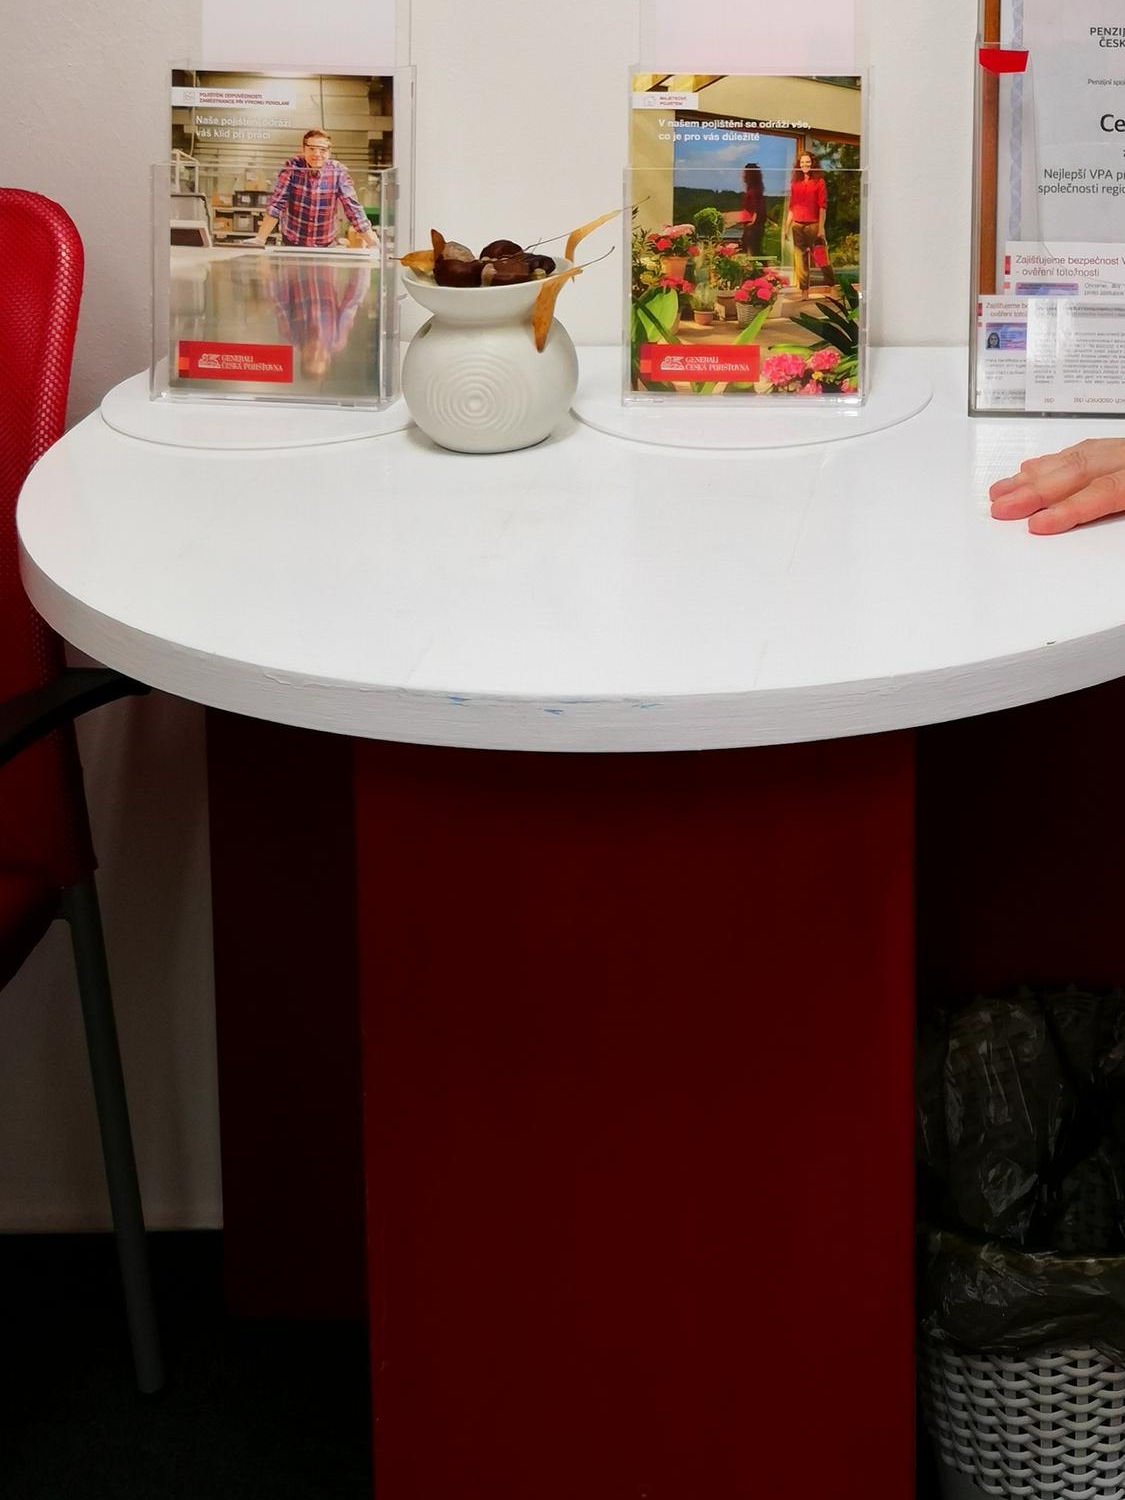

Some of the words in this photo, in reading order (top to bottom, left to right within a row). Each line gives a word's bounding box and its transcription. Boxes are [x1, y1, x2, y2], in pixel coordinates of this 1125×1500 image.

[659, 119, 665, 127] V
[668, 119, 699, 128] našem
[702, 119, 743, 129] pojištění
[759, 120, 789, 128] odráží
[792, 121, 811, 129] vše,
[659, 133, 670, 141] co
[673, 132, 681, 142] je
[684, 133, 700, 142] pro
[703, 132, 719, 141] vás
[723, 132, 760, 141] důležité
[1044, 168, 1086, 182] Nejlepší
[1089, 170, 1113, 180] VPA
[1038, 183, 1098, 198] společnosti
[1016, 255, 1065, 266] Zajišťujeme
[1068, 256, 1119, 268] bezpečnost
[1022, 267, 1054, 276] ověření
